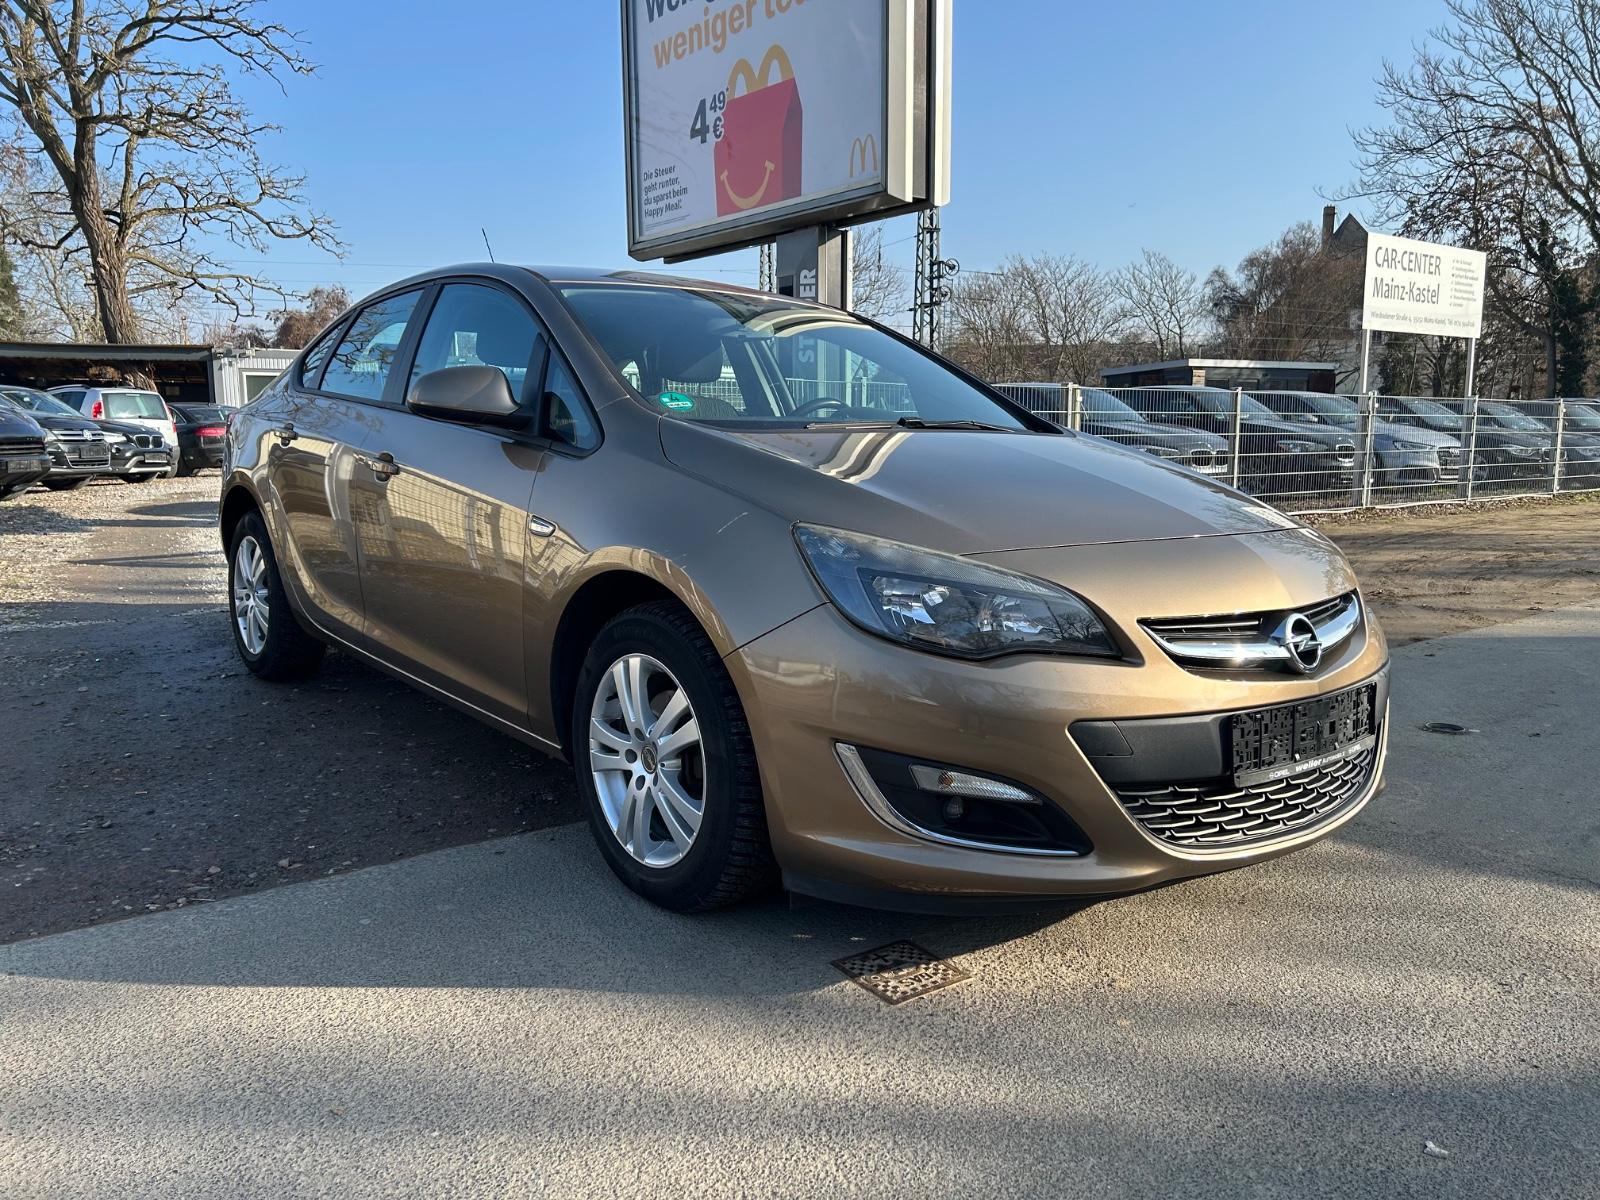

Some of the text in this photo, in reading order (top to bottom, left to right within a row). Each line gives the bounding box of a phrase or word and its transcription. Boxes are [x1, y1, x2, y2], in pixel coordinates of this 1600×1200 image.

[653, 0, 757, 69] weniger
[690, 98, 709, 144] 4
[713, 116, 723, 139] €
[644, 165, 675, 181] Die Steuer
[672, 185, 688, 198] beim
[645, 206, 664, 218] Happy
[1375, 246, 1441, 276] CAR-CENTER
[1372, 276, 1440, 305] Mainz-Kastel
[1274, 769, 1290, 778] OPEL
